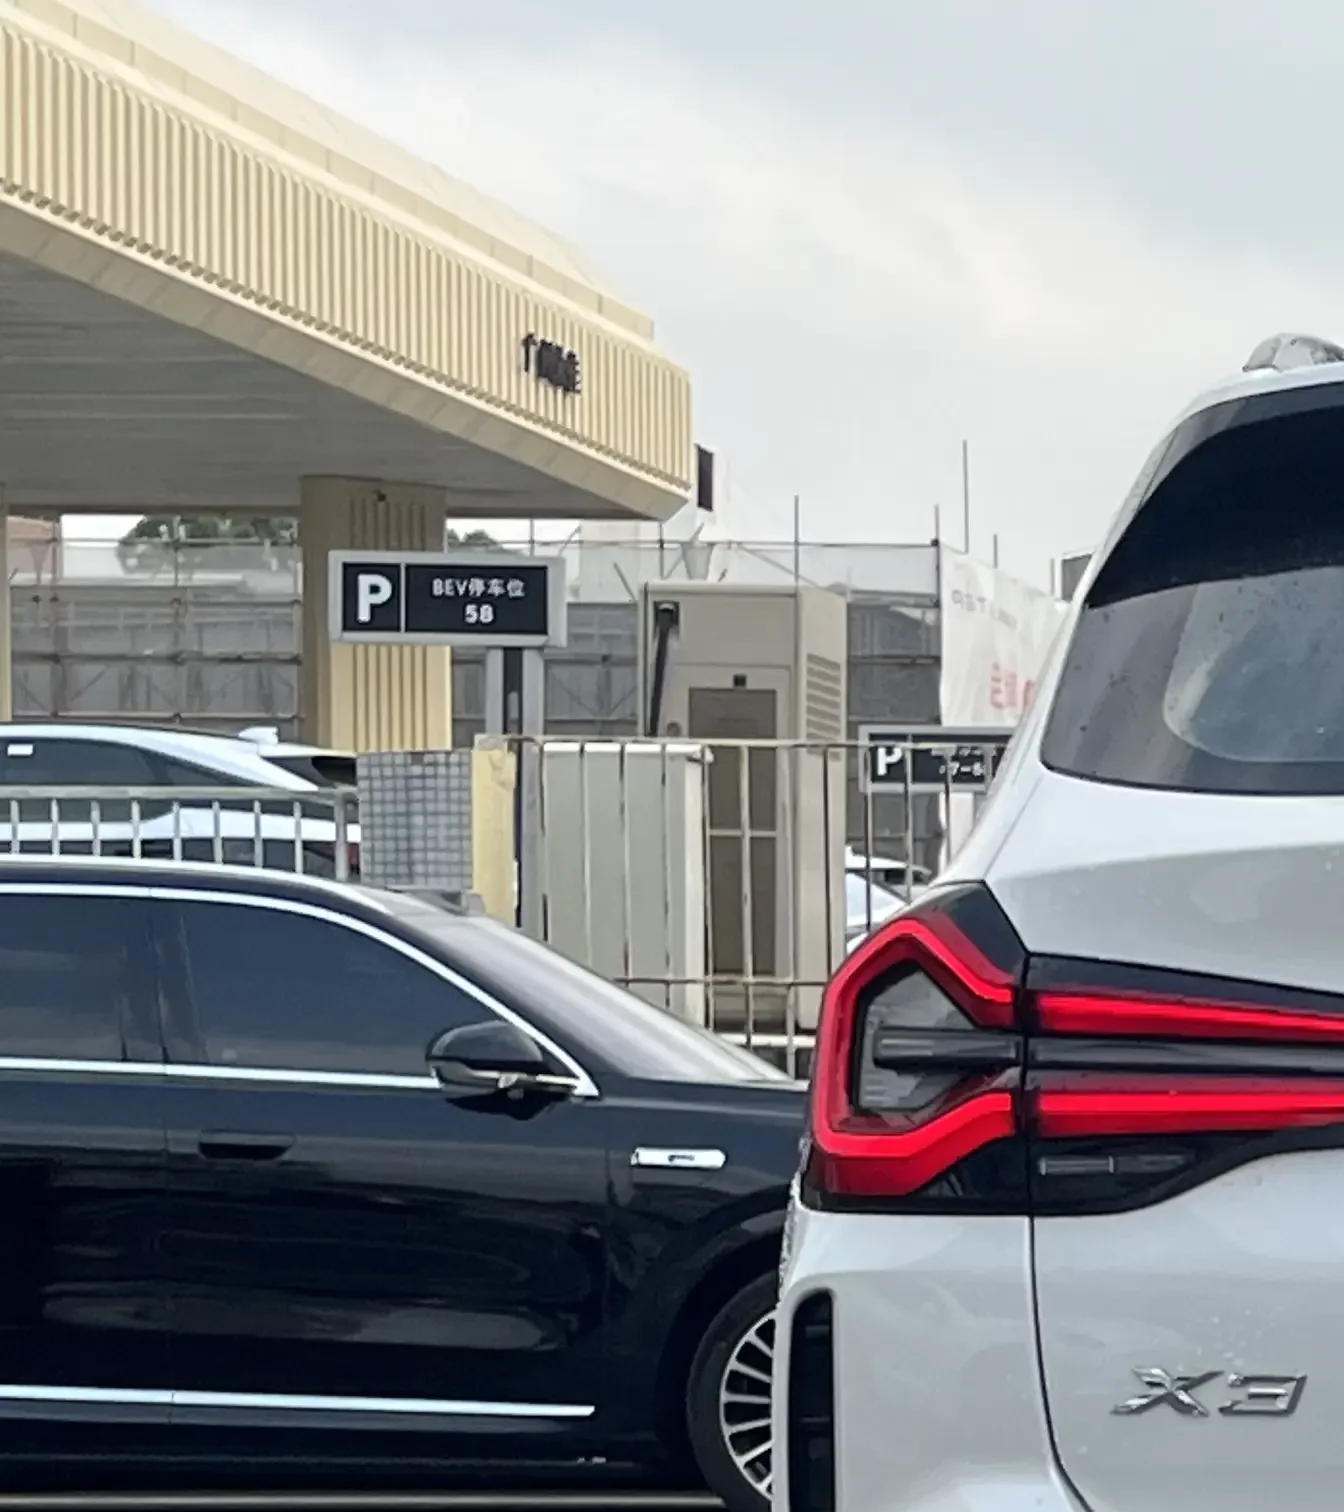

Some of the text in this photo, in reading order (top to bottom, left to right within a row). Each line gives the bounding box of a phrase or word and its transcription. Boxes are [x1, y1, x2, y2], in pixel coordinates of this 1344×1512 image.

[357, 573, 392, 623] P
[432, 577, 525, 597] BEV停车位
[1109, 1364, 1308, 1418] X3
